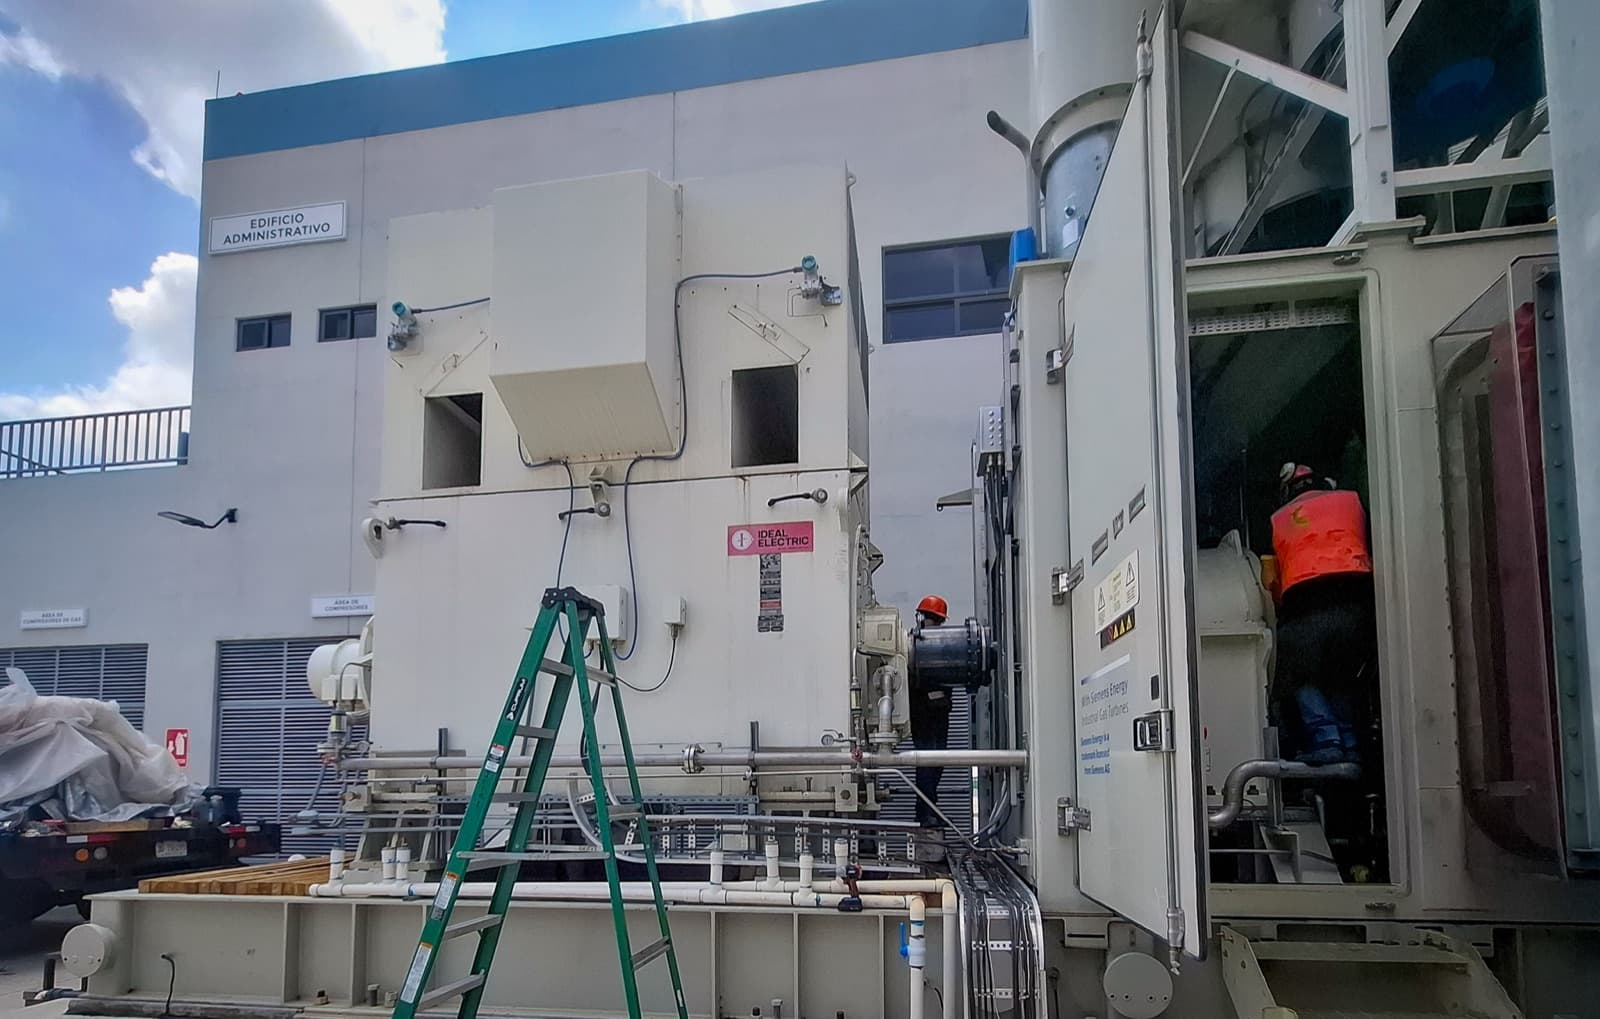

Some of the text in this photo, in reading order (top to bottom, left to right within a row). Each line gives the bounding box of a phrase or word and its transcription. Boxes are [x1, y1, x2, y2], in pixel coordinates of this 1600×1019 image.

[250, 213, 305, 229] EDIFICIO
[223, 222, 331, 245] ADMINISTRATIVO
[758, 529, 787, 539] IDEAL
[758, 536, 809, 548] ELECTRIC
[1090, 687, 1109, 704] Siemens
[1110, 680, 1128, 696] Energy
[1108, 702, 1128, 719] Turbines
